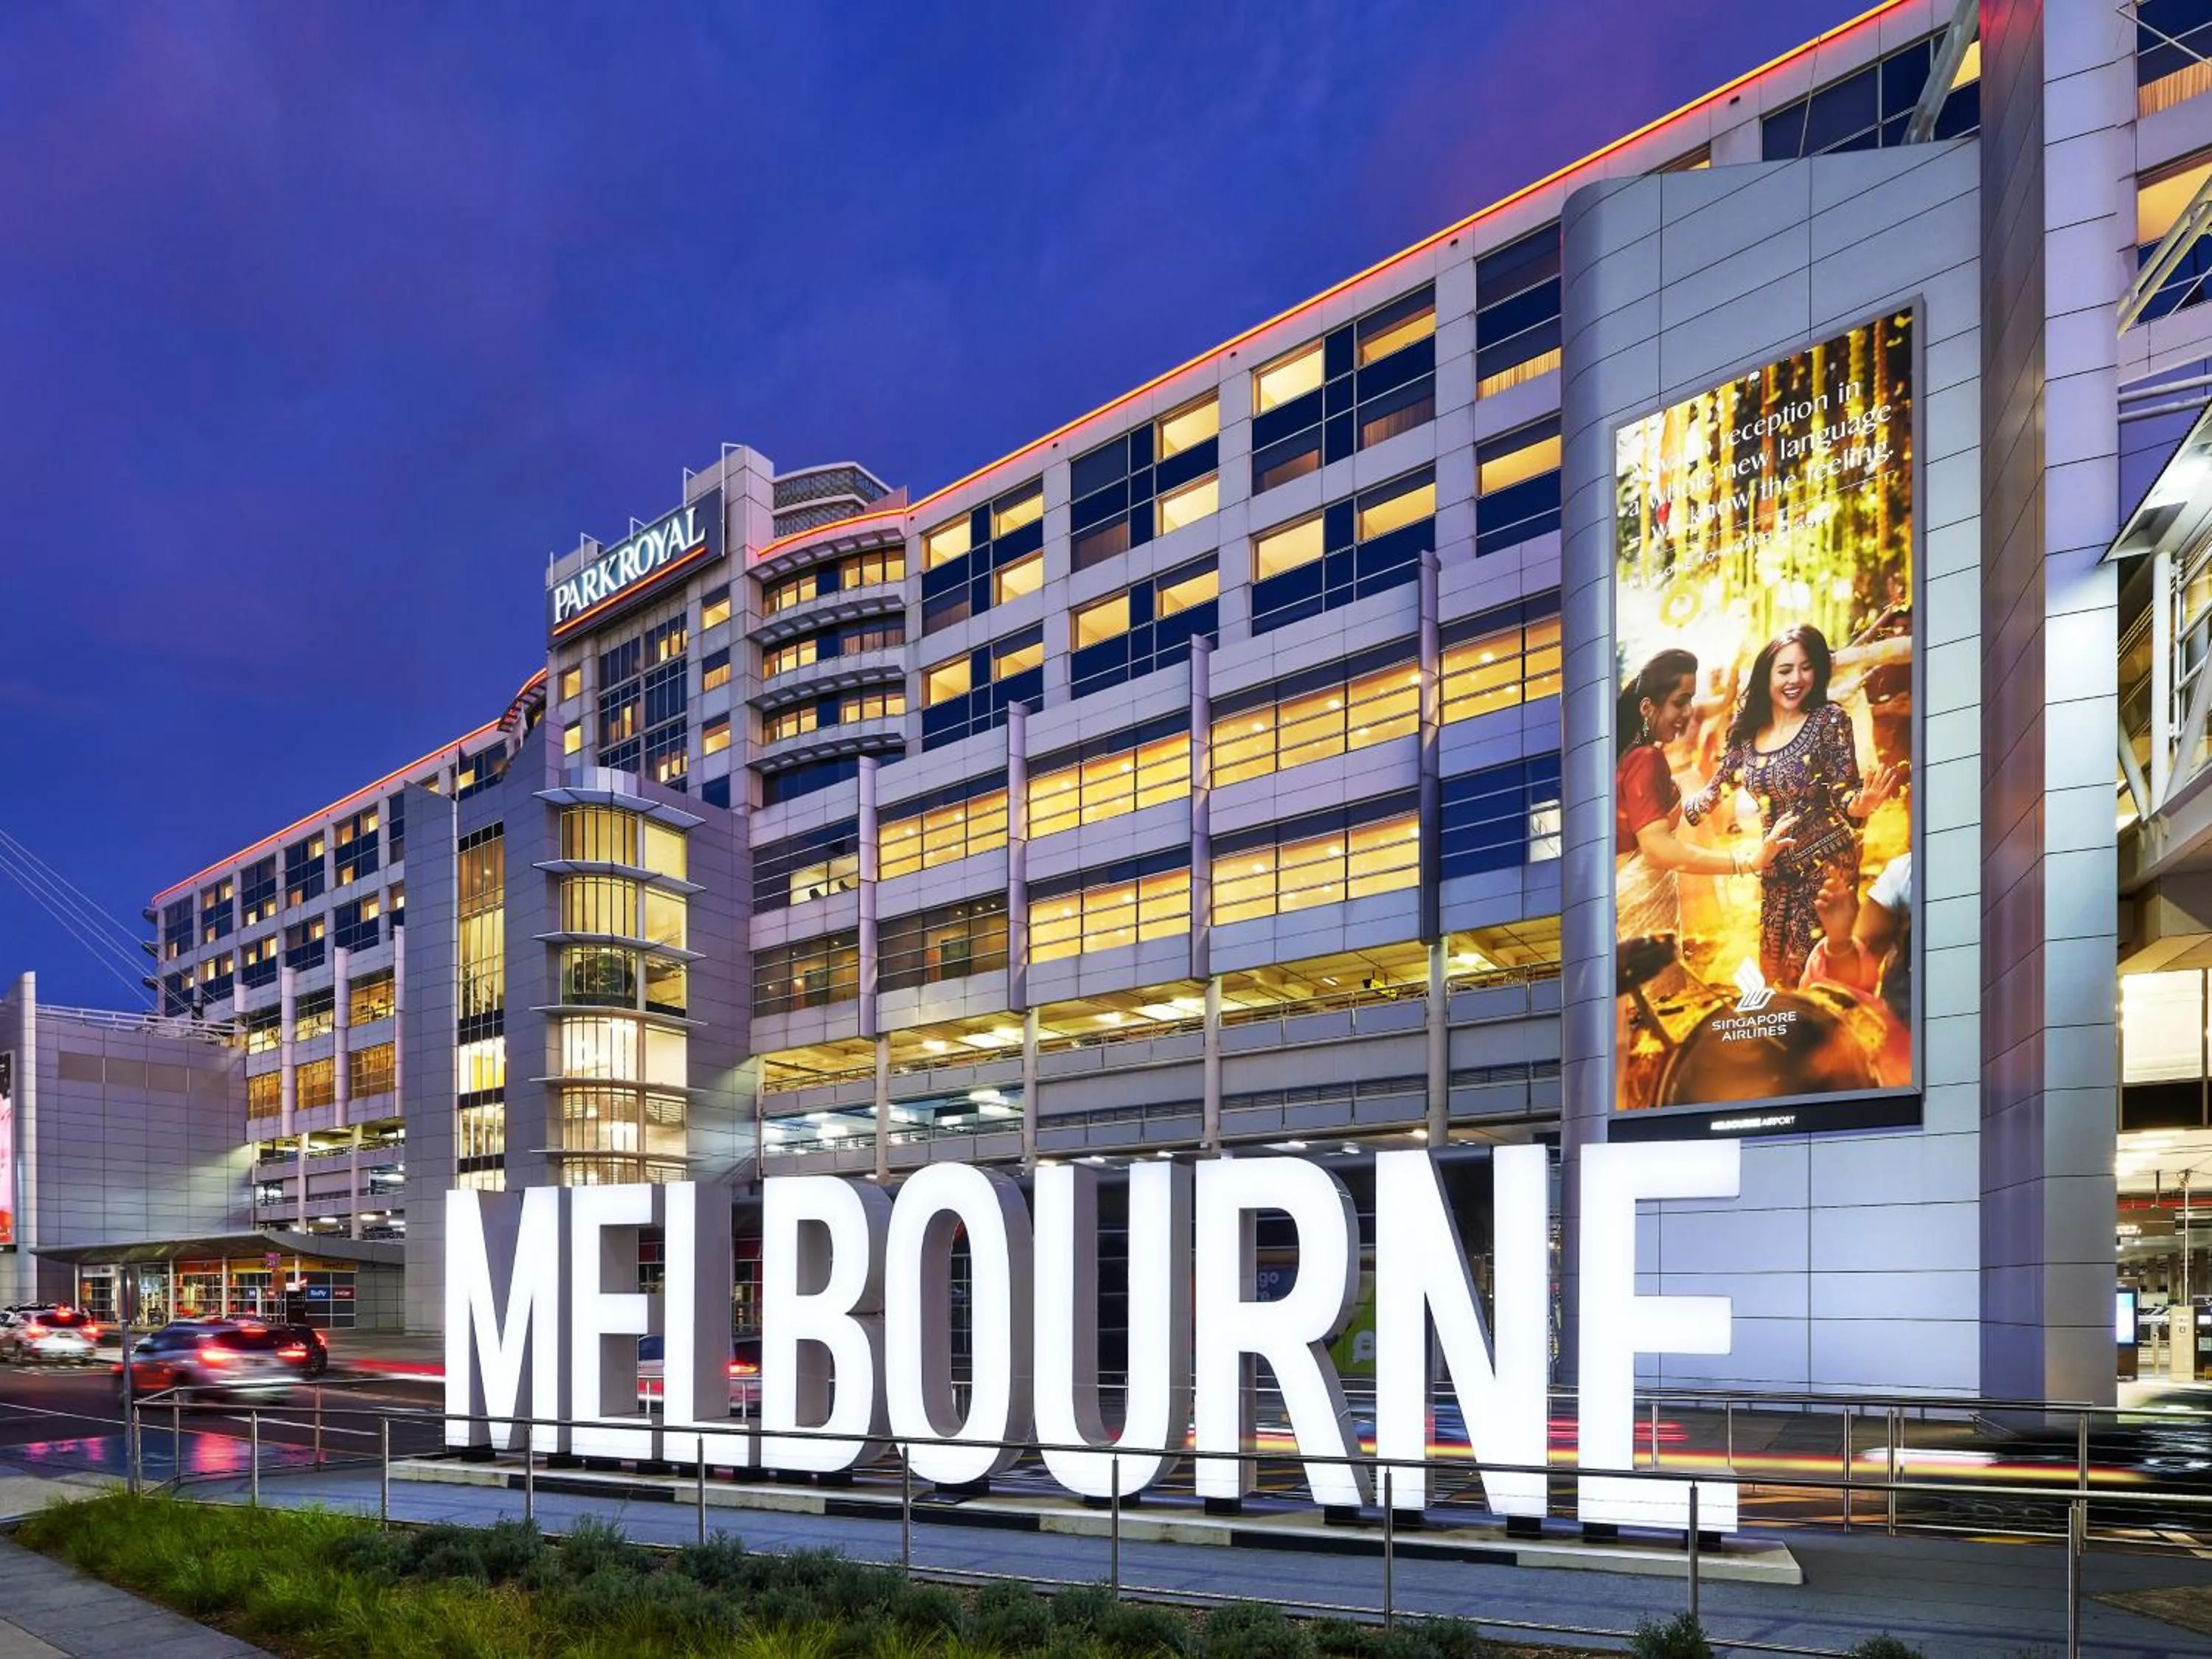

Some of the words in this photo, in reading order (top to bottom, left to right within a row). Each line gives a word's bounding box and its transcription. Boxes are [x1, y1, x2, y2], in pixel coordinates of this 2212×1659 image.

[1838, 380, 1861, 404] in
[1630, 500, 1639, 518] a
[1723, 450, 1770, 480] new
[1781, 403, 1892, 461] language
[1690, 493, 1750, 525] know
[1761, 474, 1797, 501] the
[1806, 439, 1894, 485] feeling.
[553, 507, 706, 625] PARKROYAL
[1711, 1011, 1797, 1031] SINGAPORE
[1722, 1024, 1787, 1042] AIRLINES
[445, 1139, 1741, 1533] MELBOURNE
